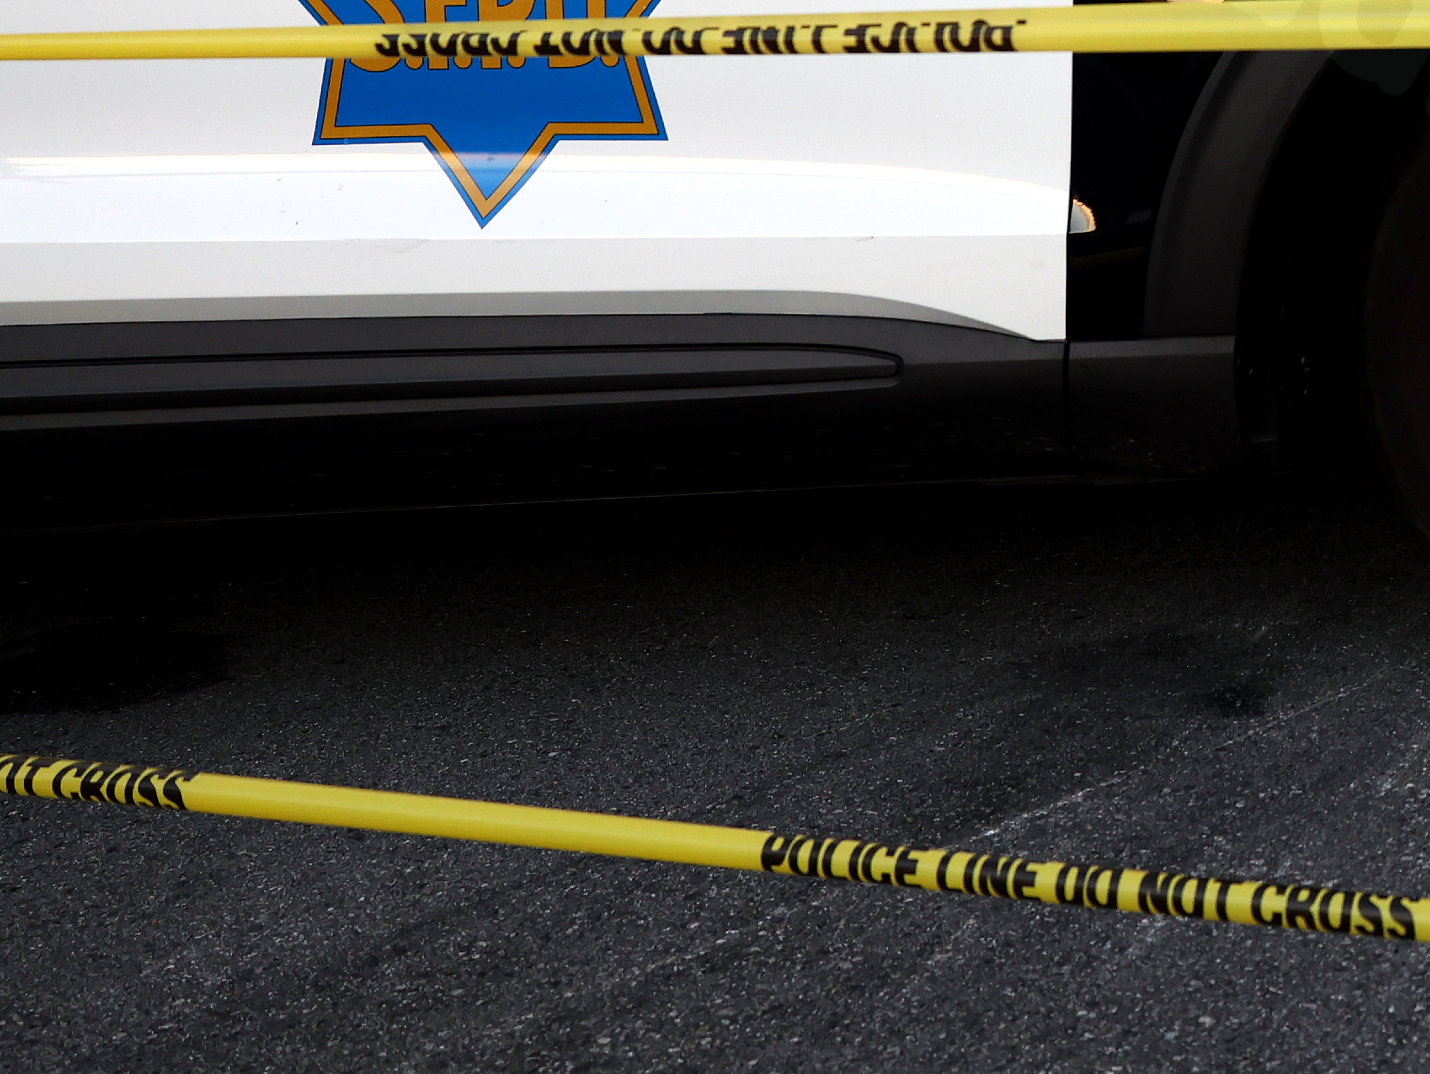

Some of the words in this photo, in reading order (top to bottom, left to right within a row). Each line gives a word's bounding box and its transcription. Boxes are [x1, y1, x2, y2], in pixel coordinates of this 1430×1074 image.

[52, 759, 197, 810] CROSS
[762, 832, 924, 887] POLICE
[936, 850, 1048, 903] LINE
[1056, 862, 1123, 911] DO
[1138, 871, 1246, 922] NOT
[1251, 883, 1416, 941] CROSS
